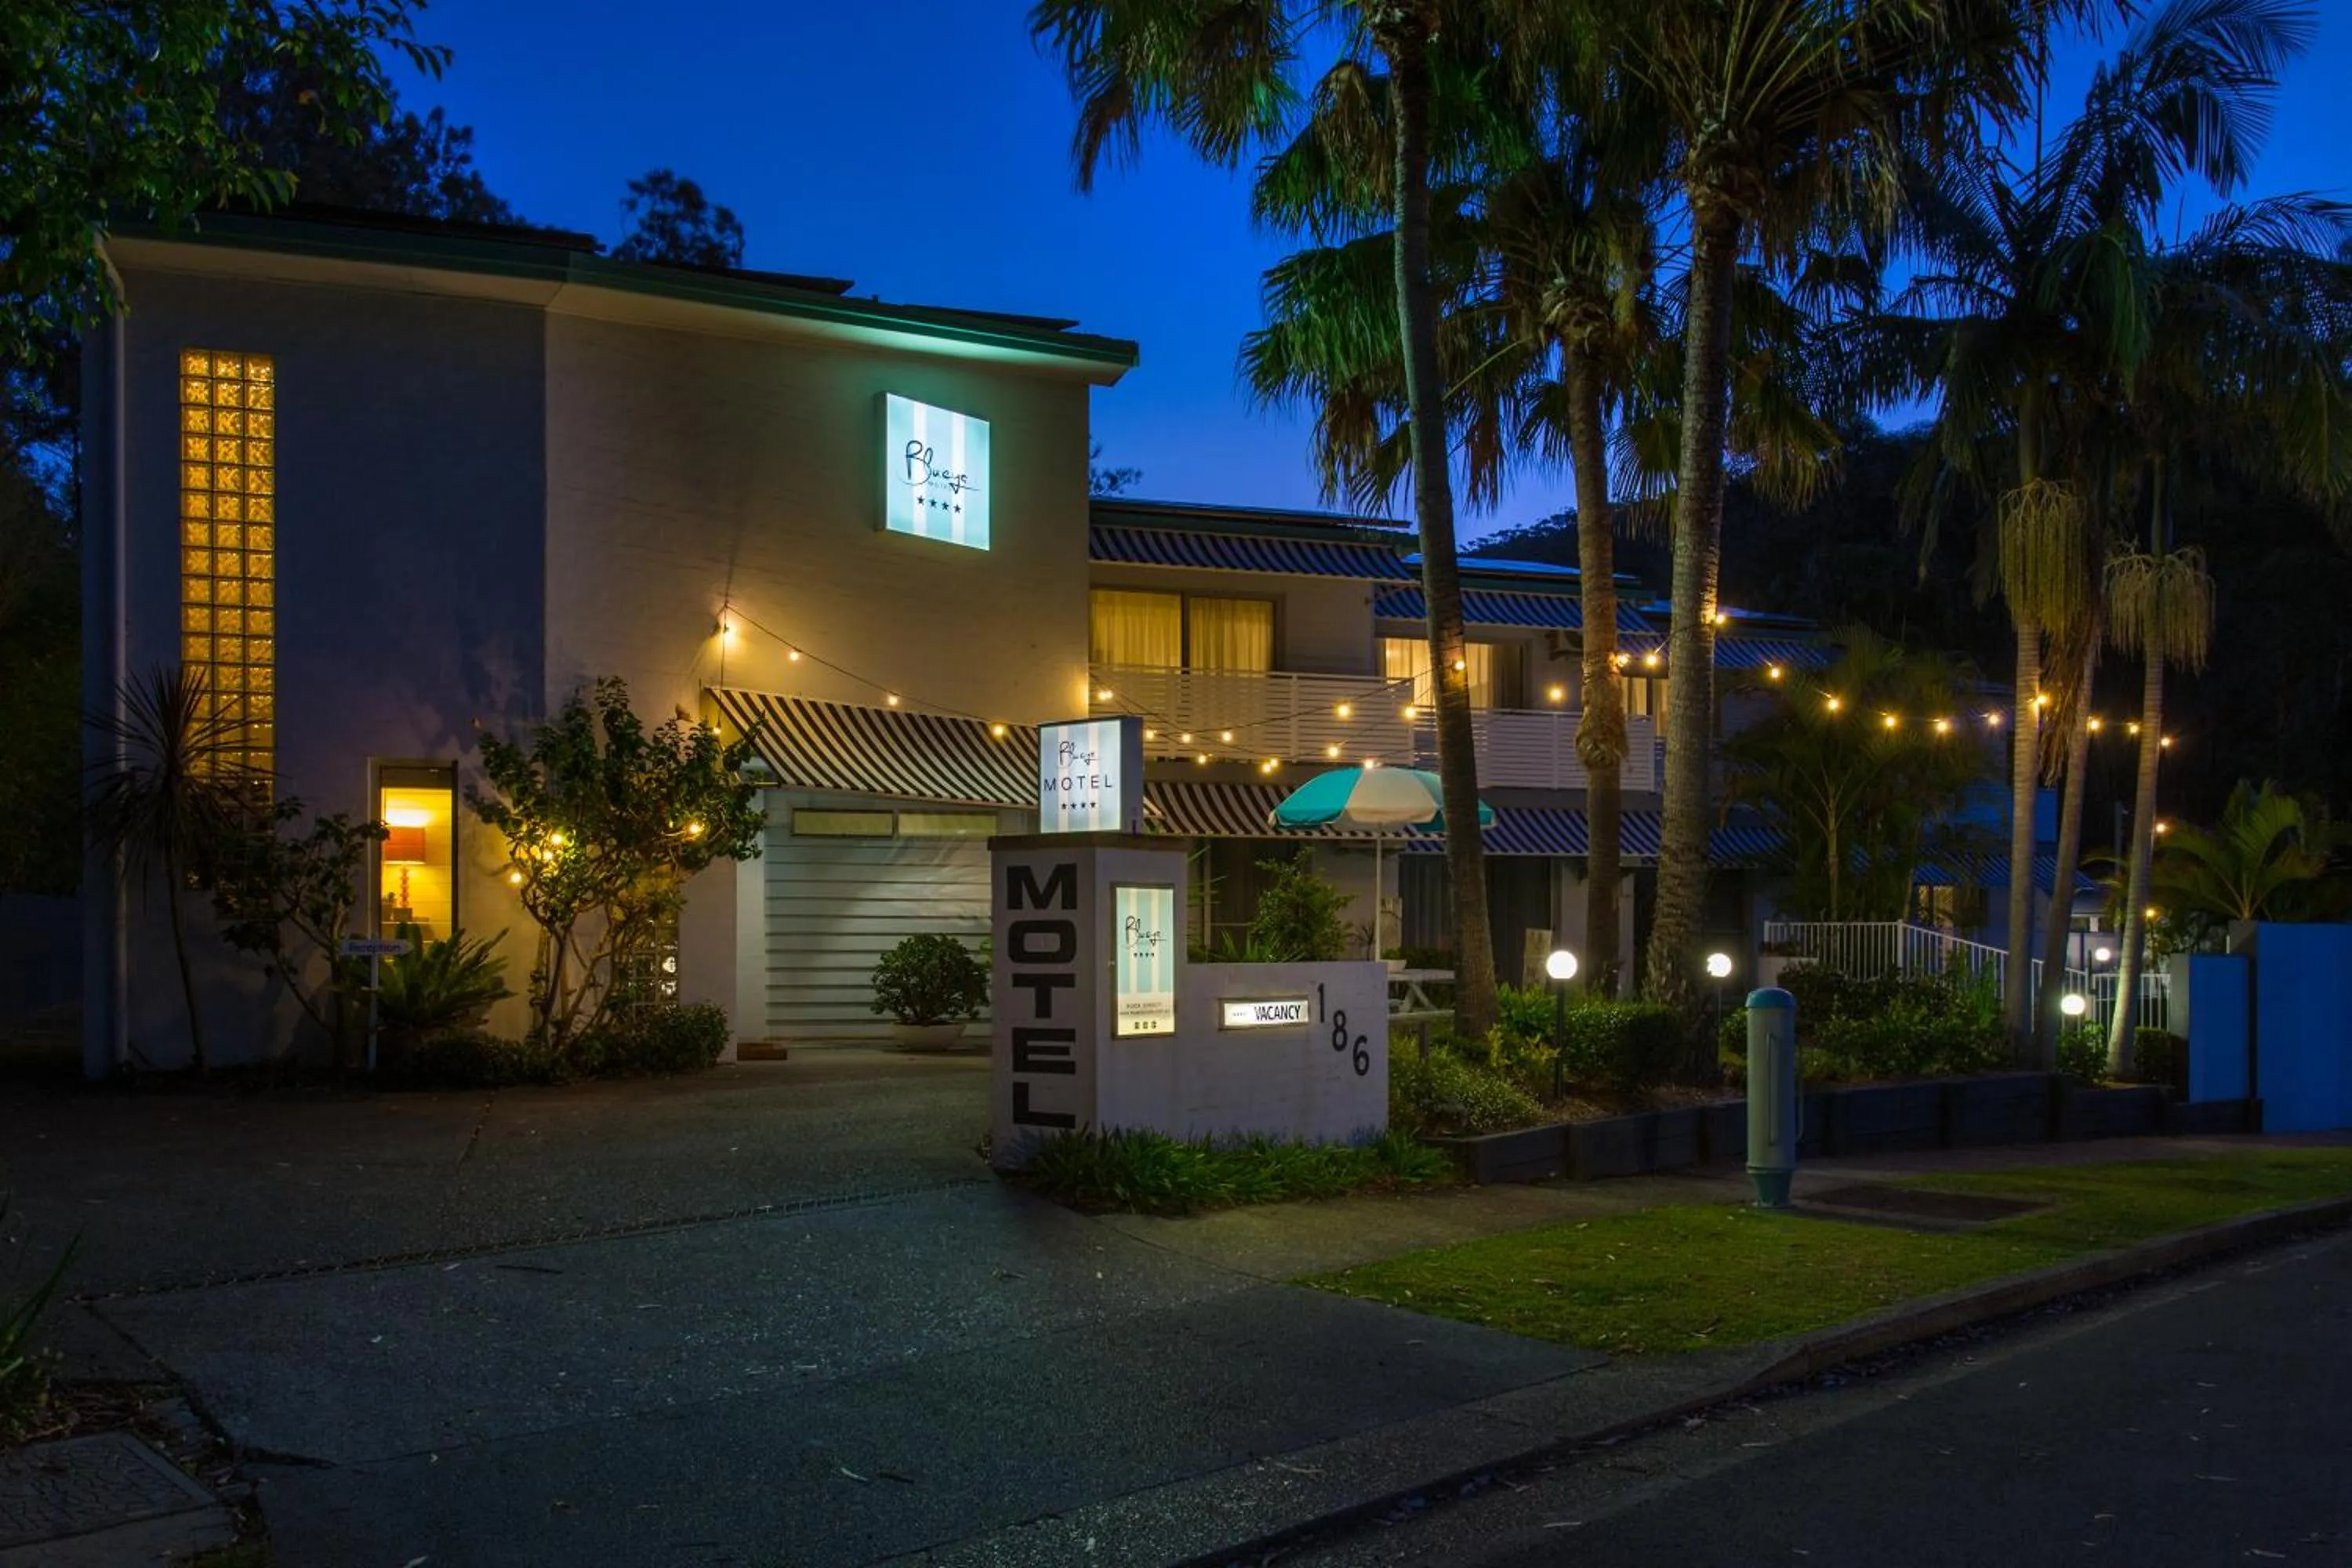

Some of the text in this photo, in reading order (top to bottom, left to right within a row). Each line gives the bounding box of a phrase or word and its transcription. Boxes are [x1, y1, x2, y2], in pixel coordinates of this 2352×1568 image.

[1044, 775, 1112, 791] MOTEL
[1007, 863, 1077, 1129] MOTEL
[1254, 1005, 1301, 1021] VACANCY
